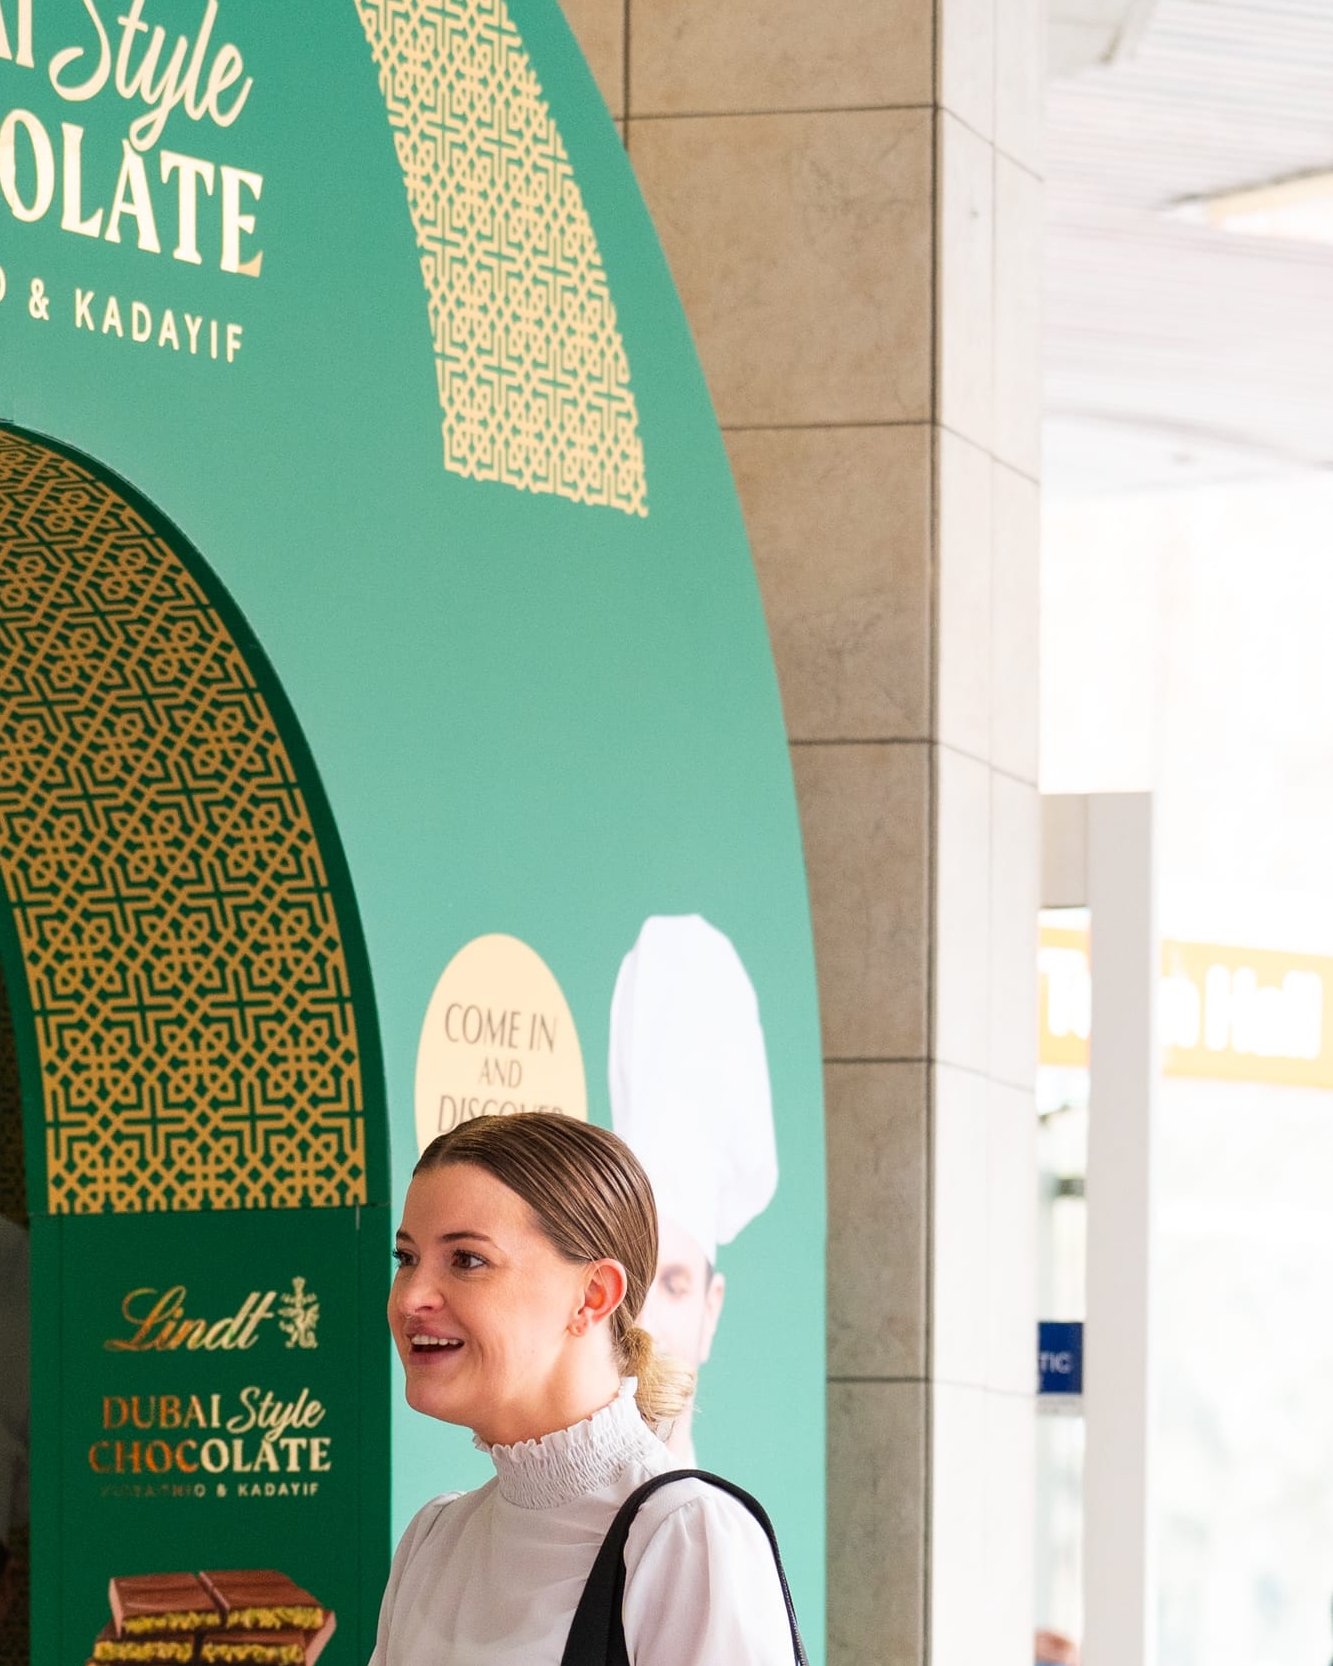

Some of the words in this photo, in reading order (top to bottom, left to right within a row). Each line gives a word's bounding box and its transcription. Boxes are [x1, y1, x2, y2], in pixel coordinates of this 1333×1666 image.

[29, 277, 50, 321] &
[75, 287, 244, 363] KADAYIF
[444, 1002, 522, 1050] COME
[529, 1012, 558, 1053] IN
[479, 1055, 523, 1089] AND
[103, 1285, 278, 1352] Lindt
[101, 1394, 222, 1430] DUBAI
[225, 1385, 327, 1441] Style
[87, 1437, 332, 1475] CHOCOLATE
[237, 1482, 320, 1497] KADAYIF
